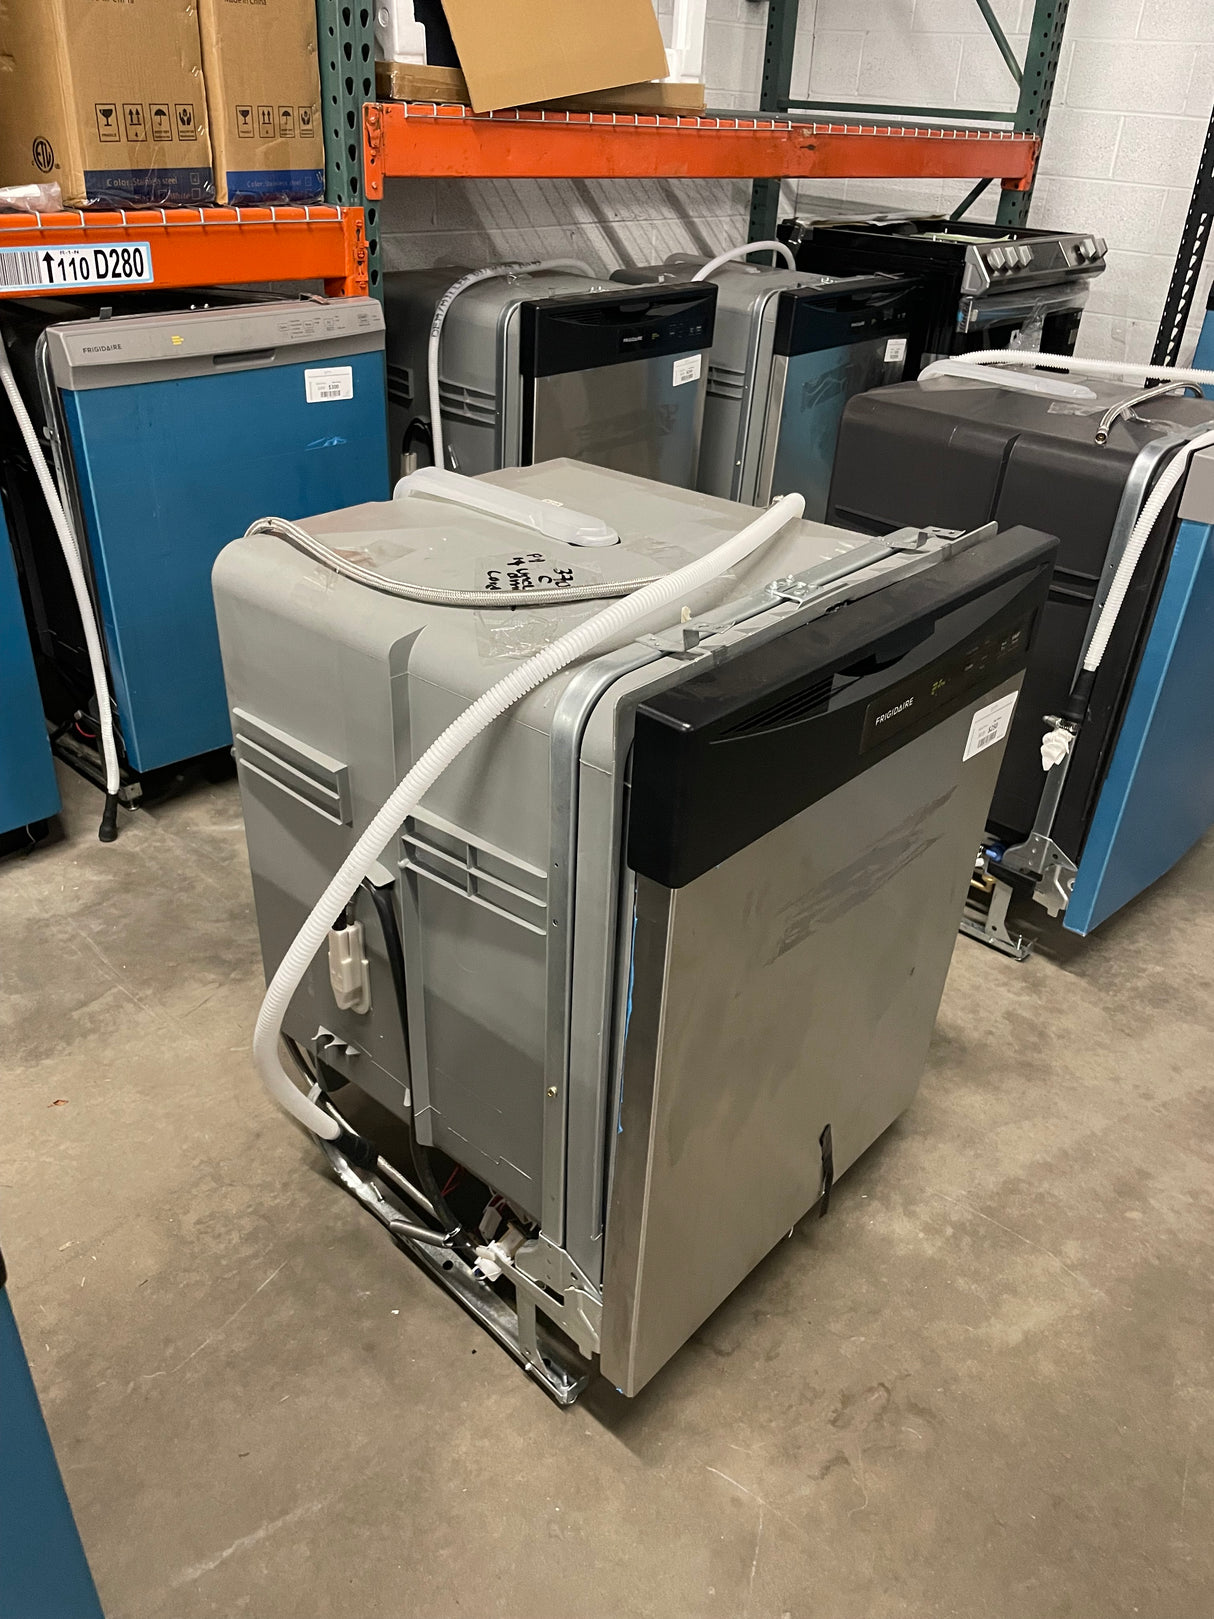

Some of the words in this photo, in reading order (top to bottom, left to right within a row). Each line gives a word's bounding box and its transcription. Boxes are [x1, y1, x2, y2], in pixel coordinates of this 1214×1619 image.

[57, 257, 90, 281] 110
[93, 247, 144, 280] D280
[82, 343, 122, 353] FRIGIDAIRE
[875, 696, 914, 726] FRIGIDAIRE
